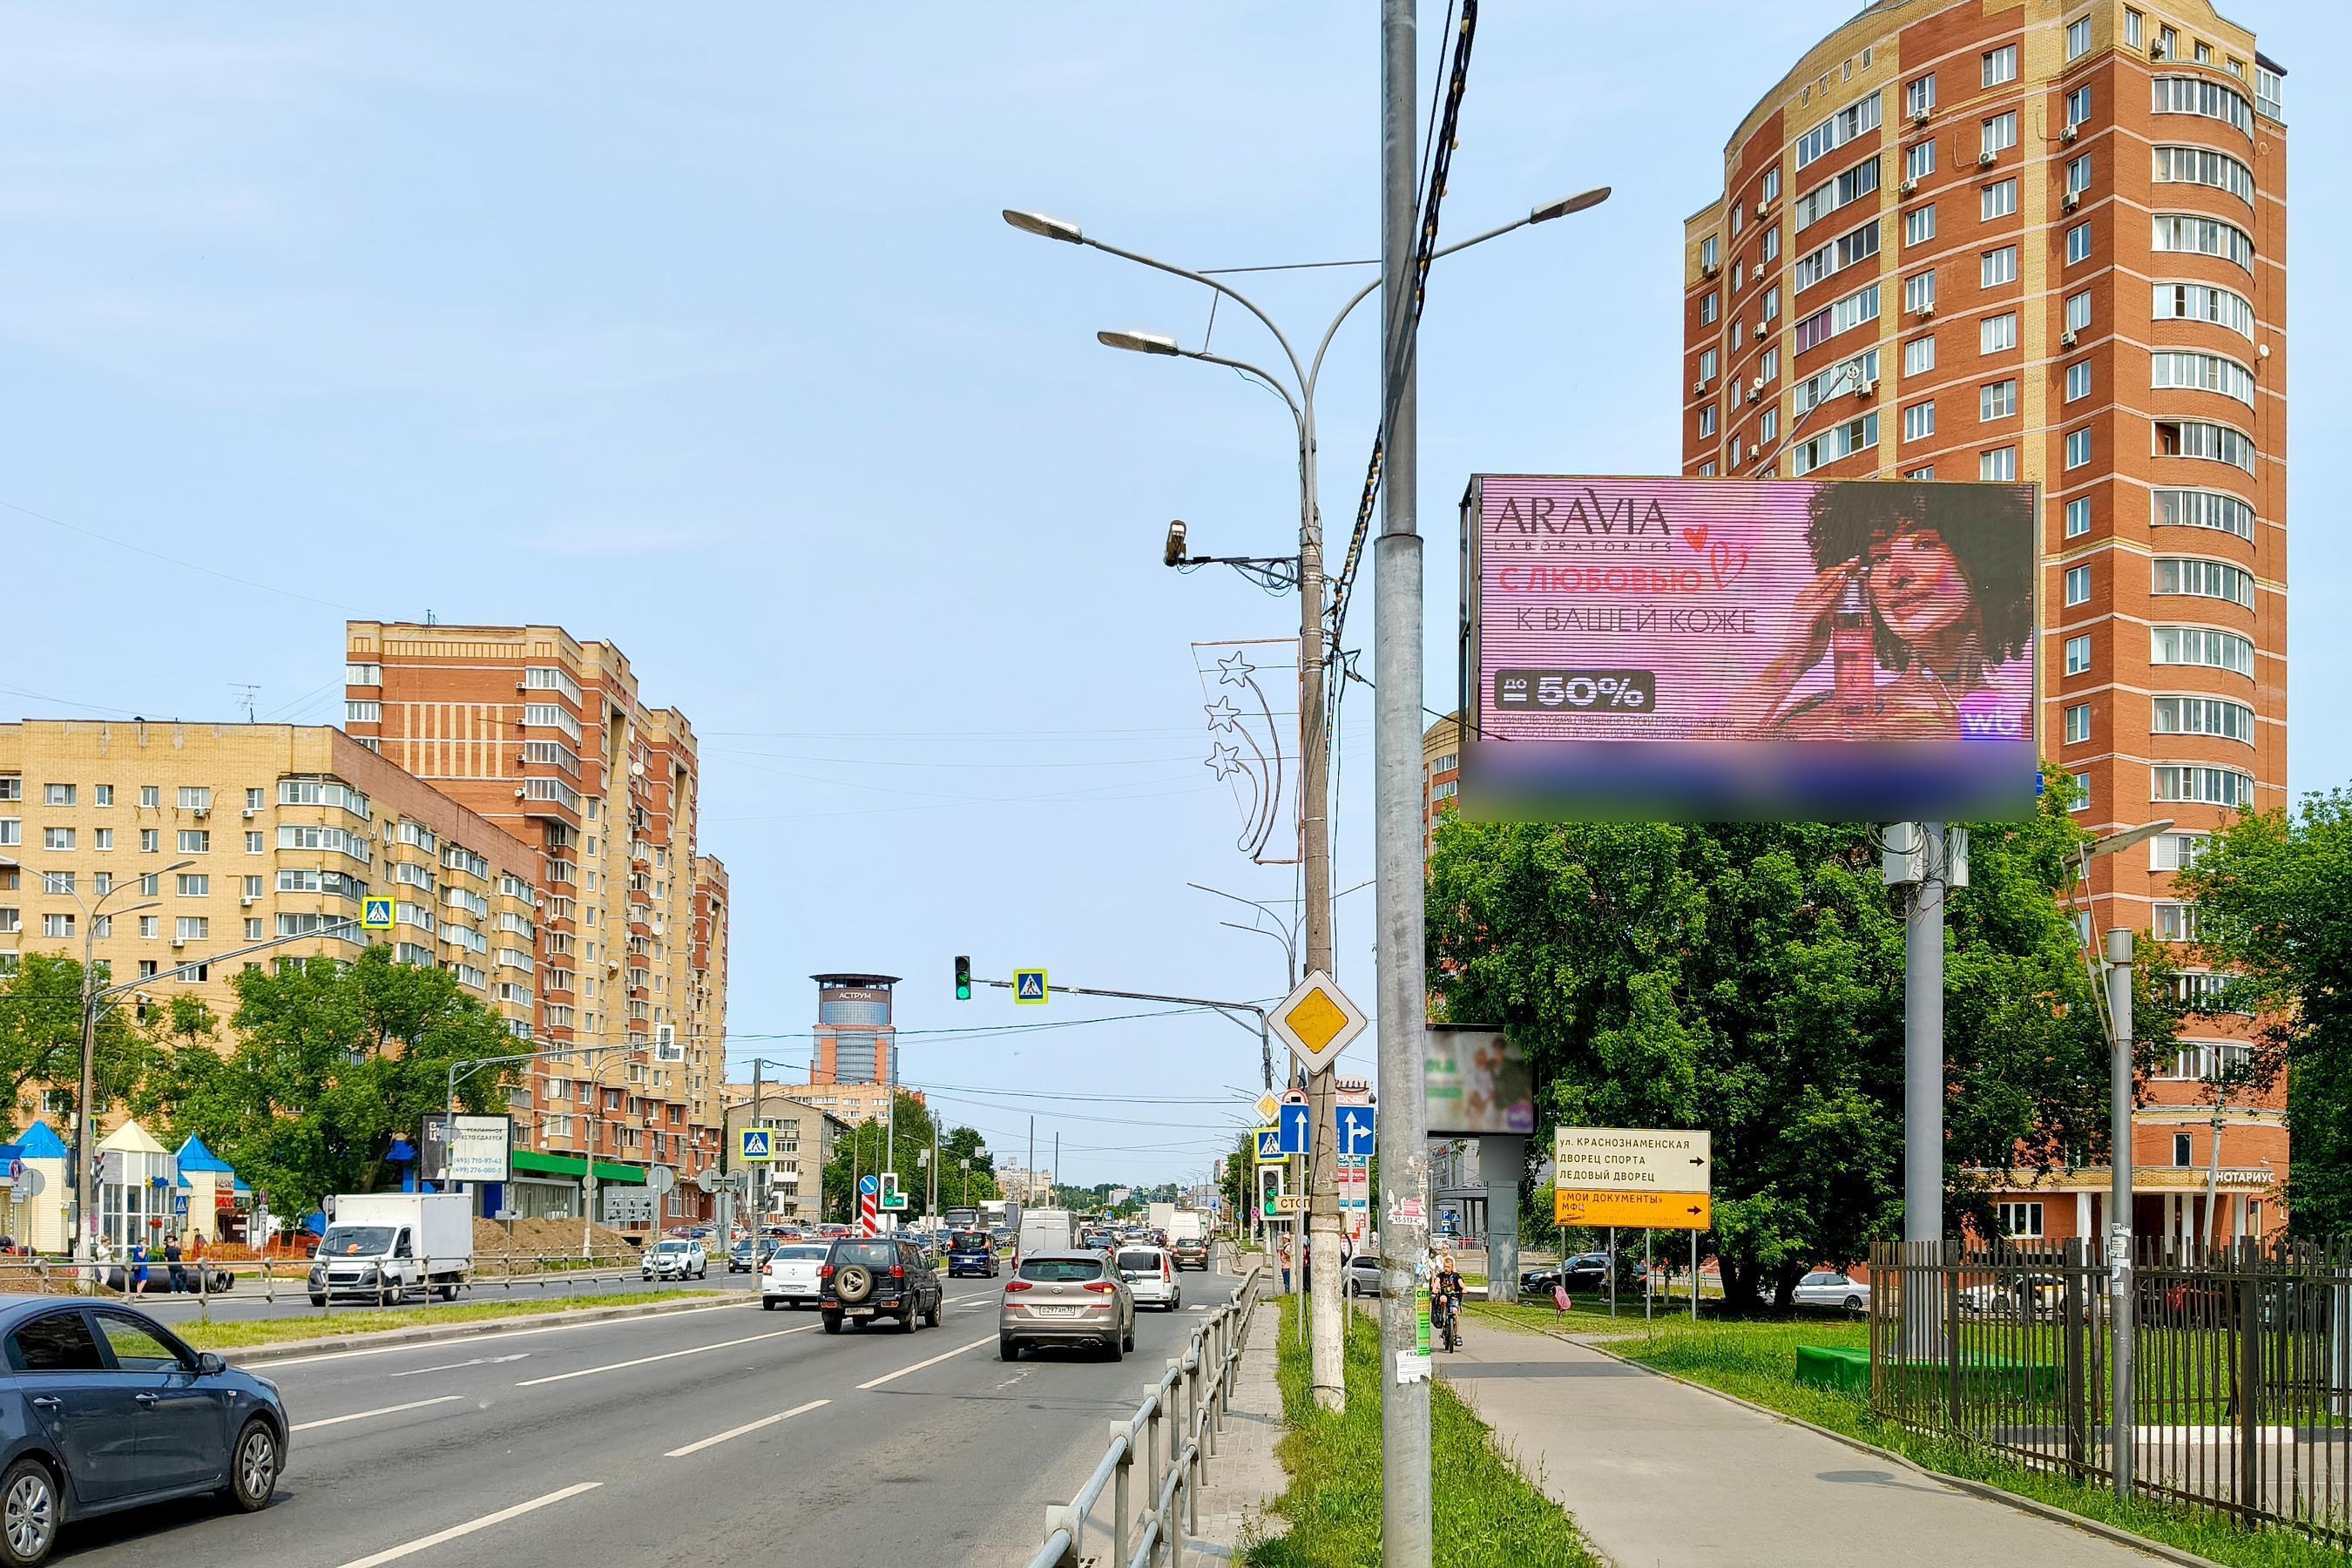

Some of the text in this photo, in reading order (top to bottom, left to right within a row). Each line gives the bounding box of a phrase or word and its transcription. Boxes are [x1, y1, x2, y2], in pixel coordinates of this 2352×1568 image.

[1494, 487, 1672, 536] ARAVIA
[1494, 540, 1672, 552] LABORATORIES
[1527, 567, 1702, 593] ЛЮБОВЬЮ
[1517, 604, 1756, 634] К ВАШЕЙ КОЖЕ
[1537, 676, 1645, 707] 50%
[1964, 706, 2017, 735] wb
[1336, 1094, 1364, 1103] DNS
[1577, 1138, 1690, 1150] КРАСНОЗНАМЕНСКАЯ
[1559, 1154, 1646, 1165] ДВОРЕЦ СПОРТА
[1559, 1170, 1655, 1183] ЛЕДОВЫЙ ДВОРЕЦ
[2216, 1172, 2275, 1183] НОТАРИУС
